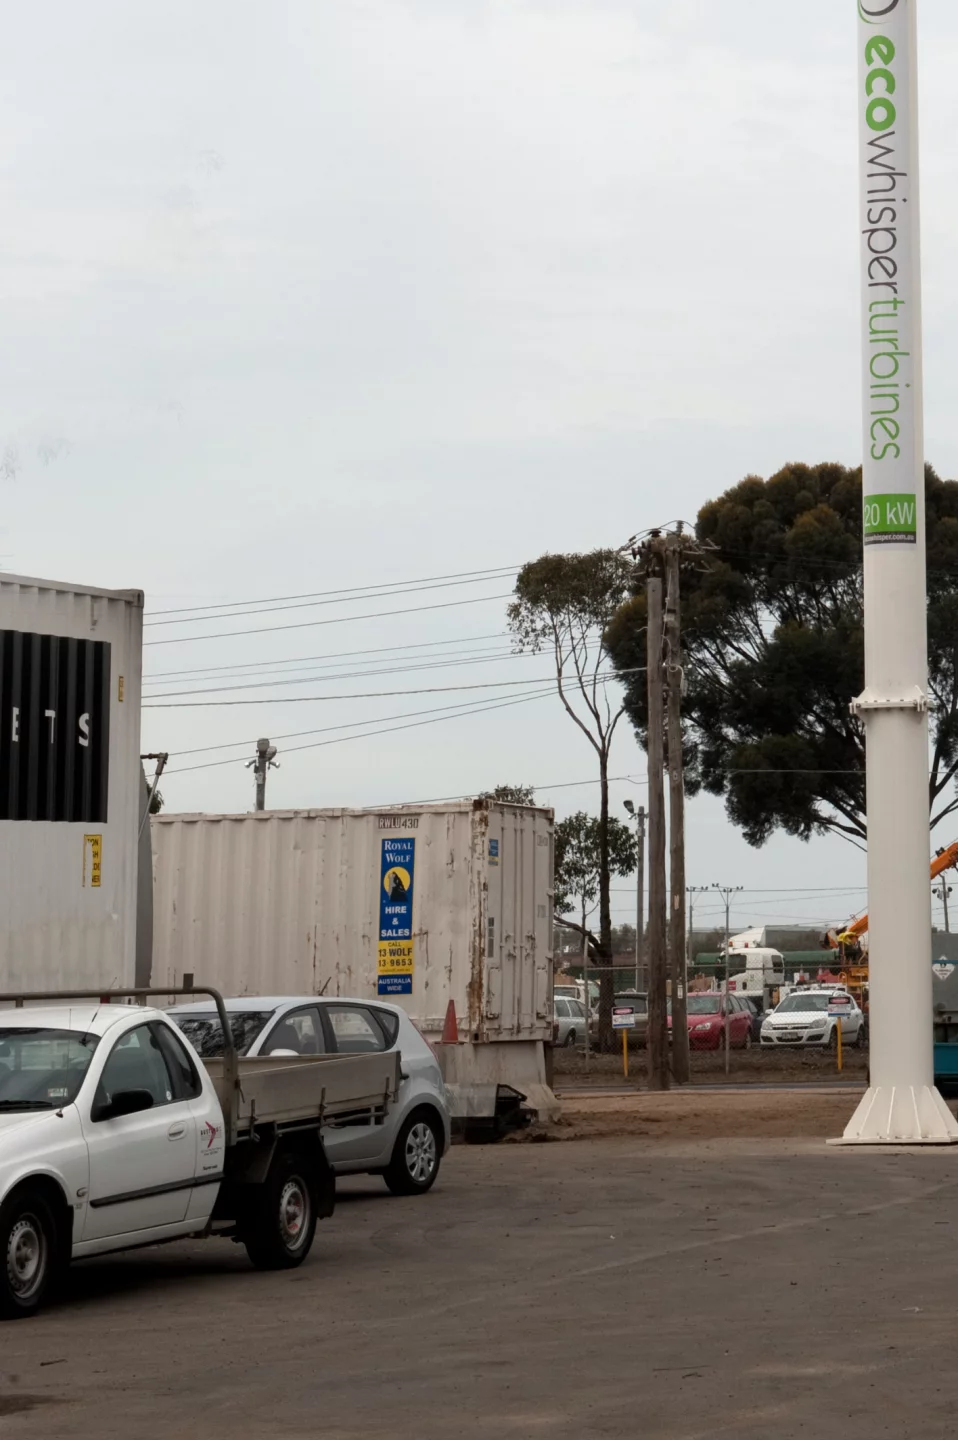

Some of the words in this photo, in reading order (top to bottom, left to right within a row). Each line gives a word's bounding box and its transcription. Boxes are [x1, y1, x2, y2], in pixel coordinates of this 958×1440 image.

[864, 503, 880, 527] 20
[886, 502, 914, 525] kW
[380, 818, 399, 828] RWLU
[385, 906, 407, 914] HIRE
[381, 928, 410, 937] SALES
